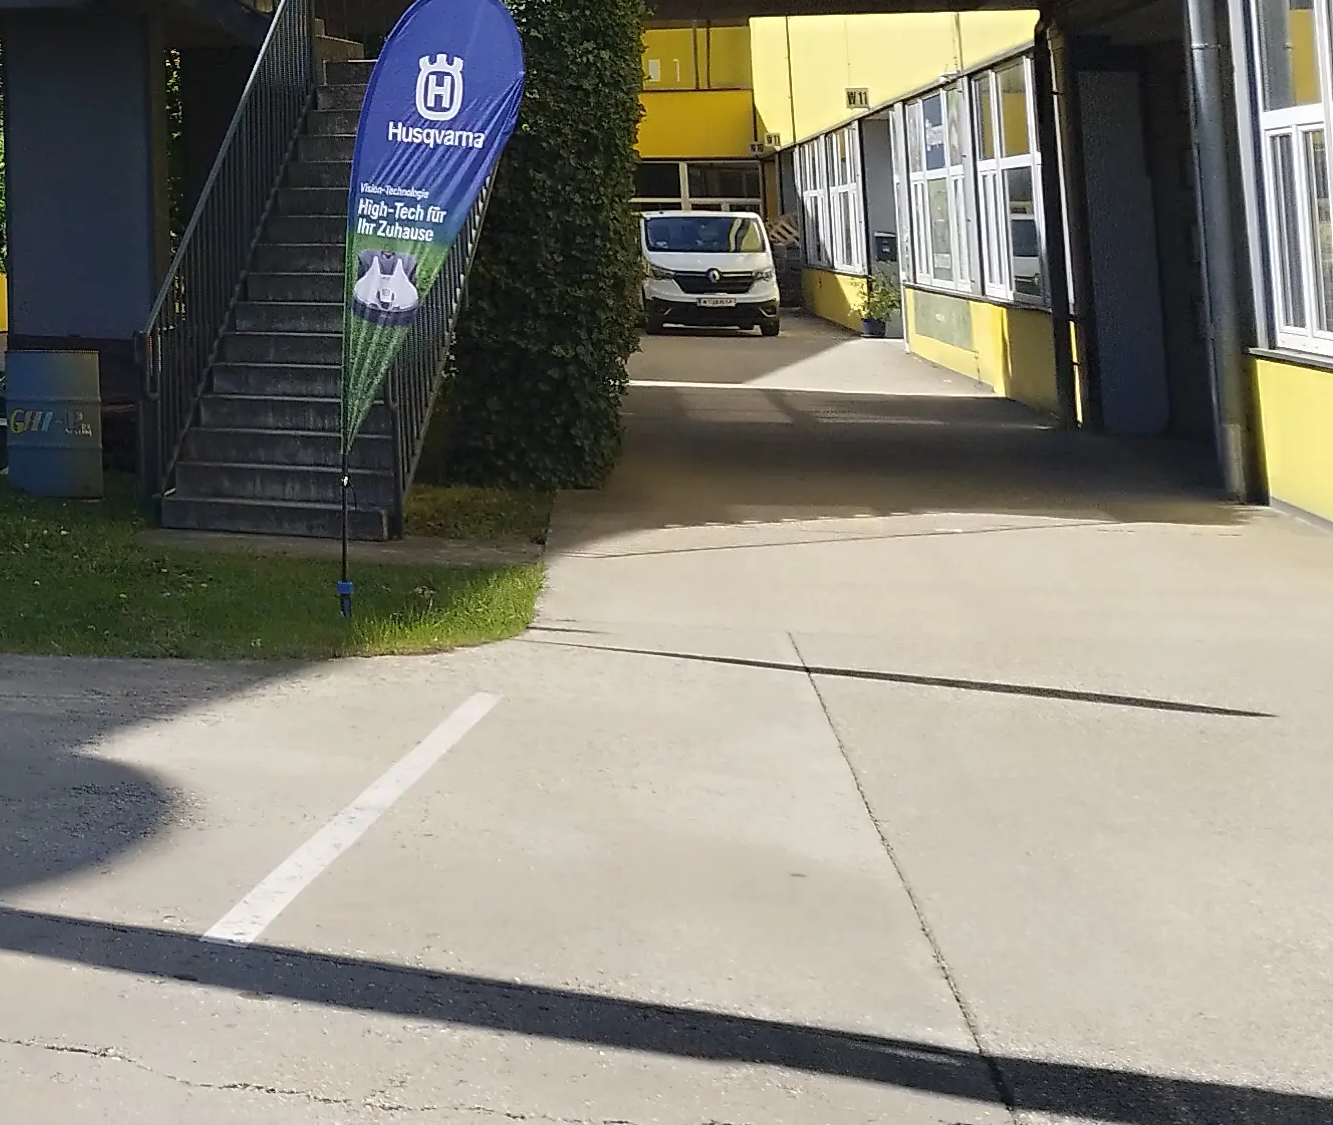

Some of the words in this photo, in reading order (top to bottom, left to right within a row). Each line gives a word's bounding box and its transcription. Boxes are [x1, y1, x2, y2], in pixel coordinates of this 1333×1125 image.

[387, 121, 486, 149] Husqvarna
[357, 197, 425, 221] High-Tech
[426, 205, 448, 224] für
[357, 217, 376, 236] Ihr
[376, 220, 434, 242] Zuhause
